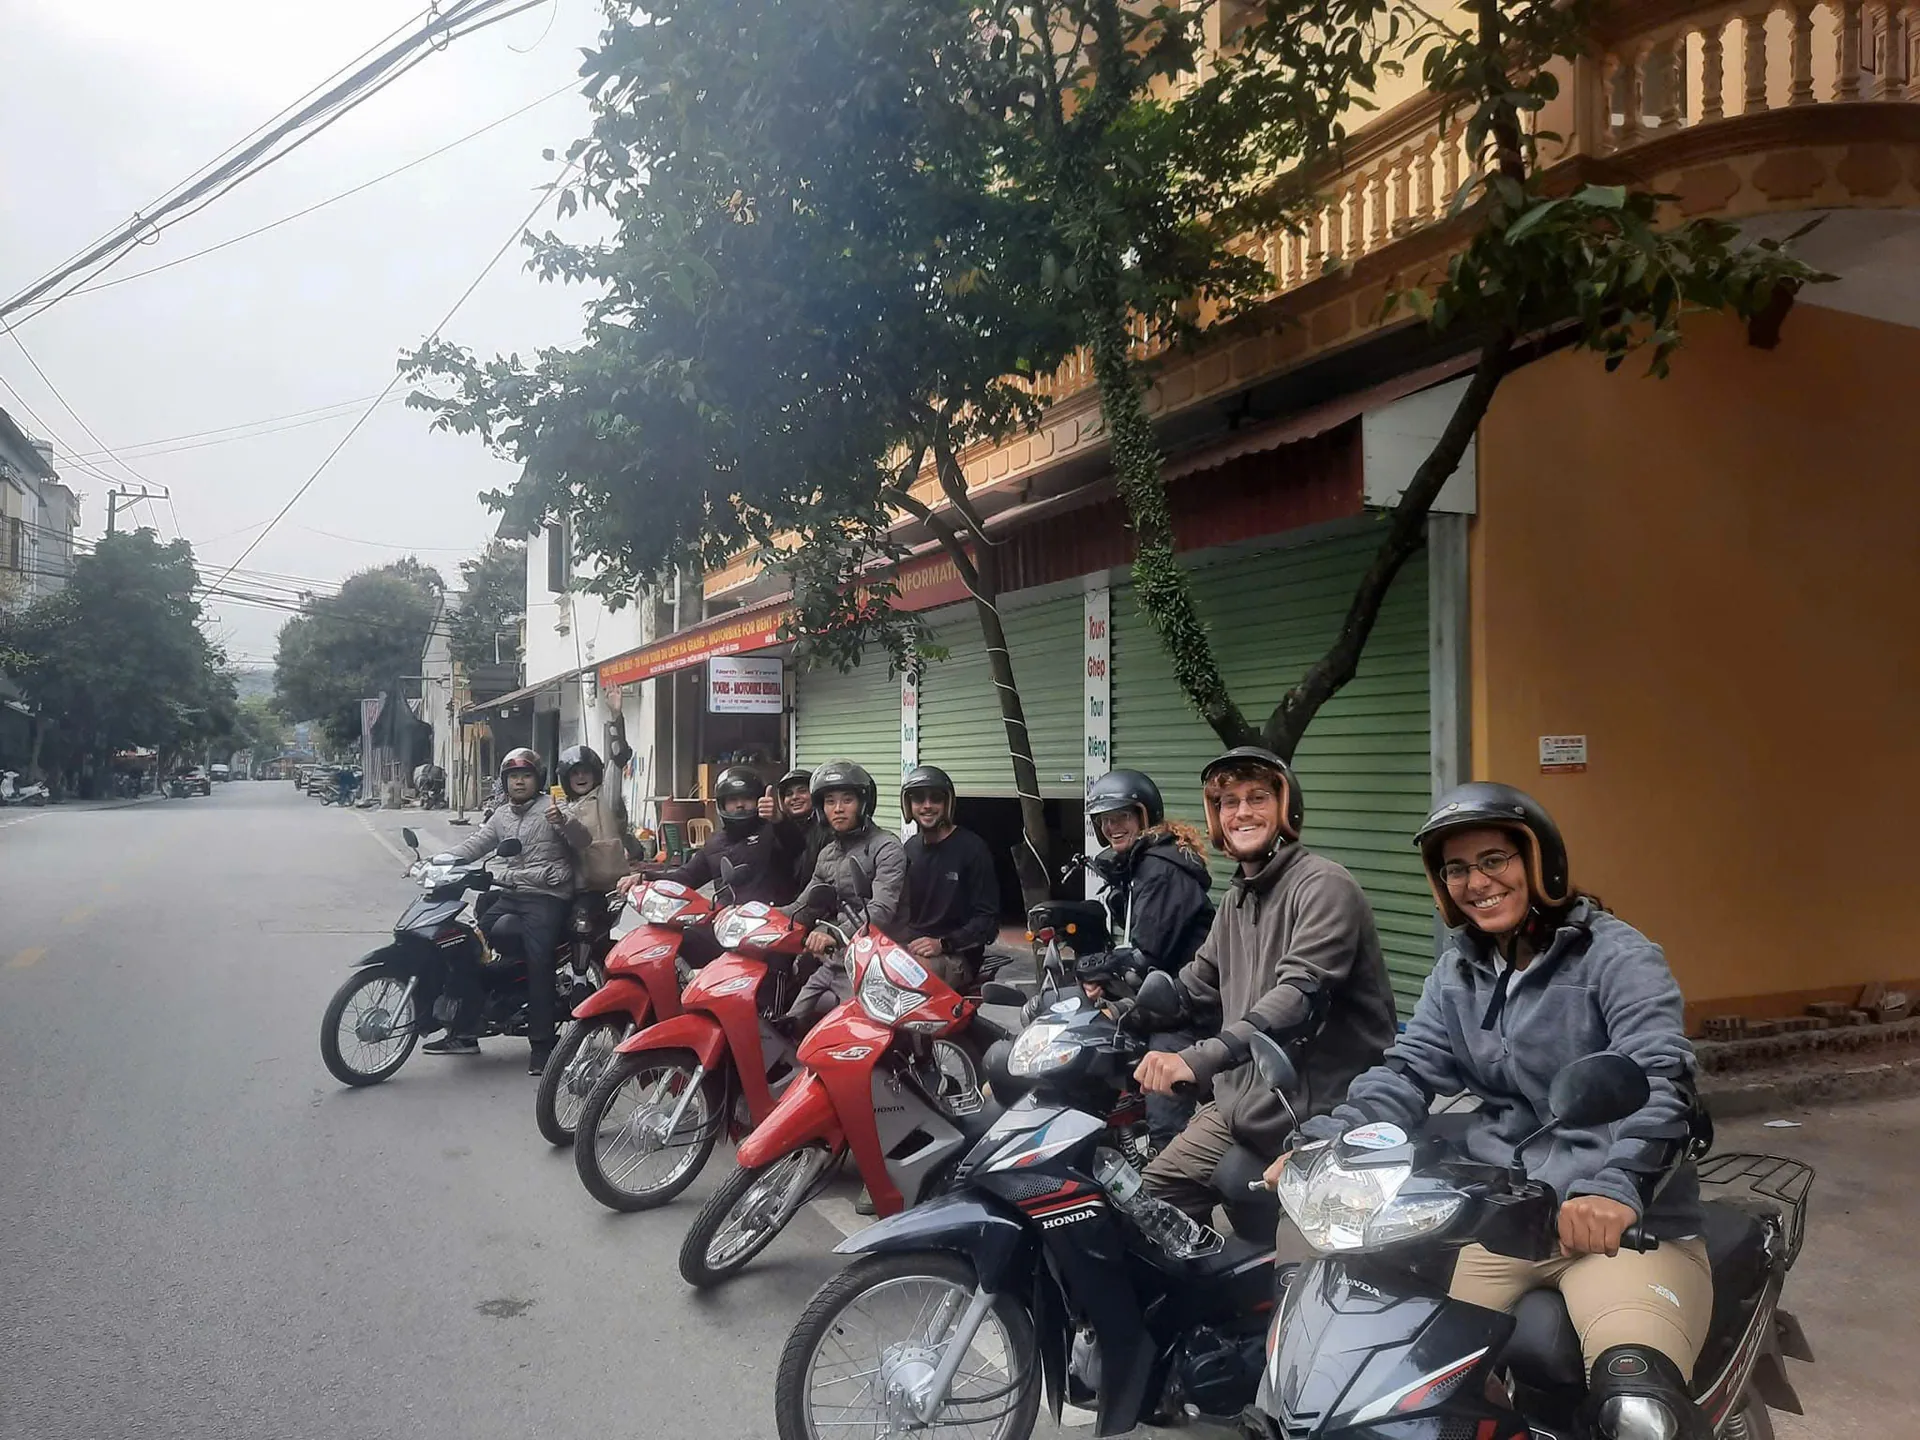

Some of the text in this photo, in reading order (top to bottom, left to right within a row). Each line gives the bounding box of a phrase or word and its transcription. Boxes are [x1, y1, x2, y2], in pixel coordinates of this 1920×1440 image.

[896, 557, 976, 593] INFORMATI
[1089, 616, 1106, 641] Tours
[1087, 653, 1106, 681] Ghép
[712, 681, 730, 695] TOURS
[1090, 696, 1104, 717] Tour
[873, 1105, 905, 1114] HONDA
[1042, 1209, 1097, 1229] HONDA
[1336, 1277, 1381, 1298] HONDA
